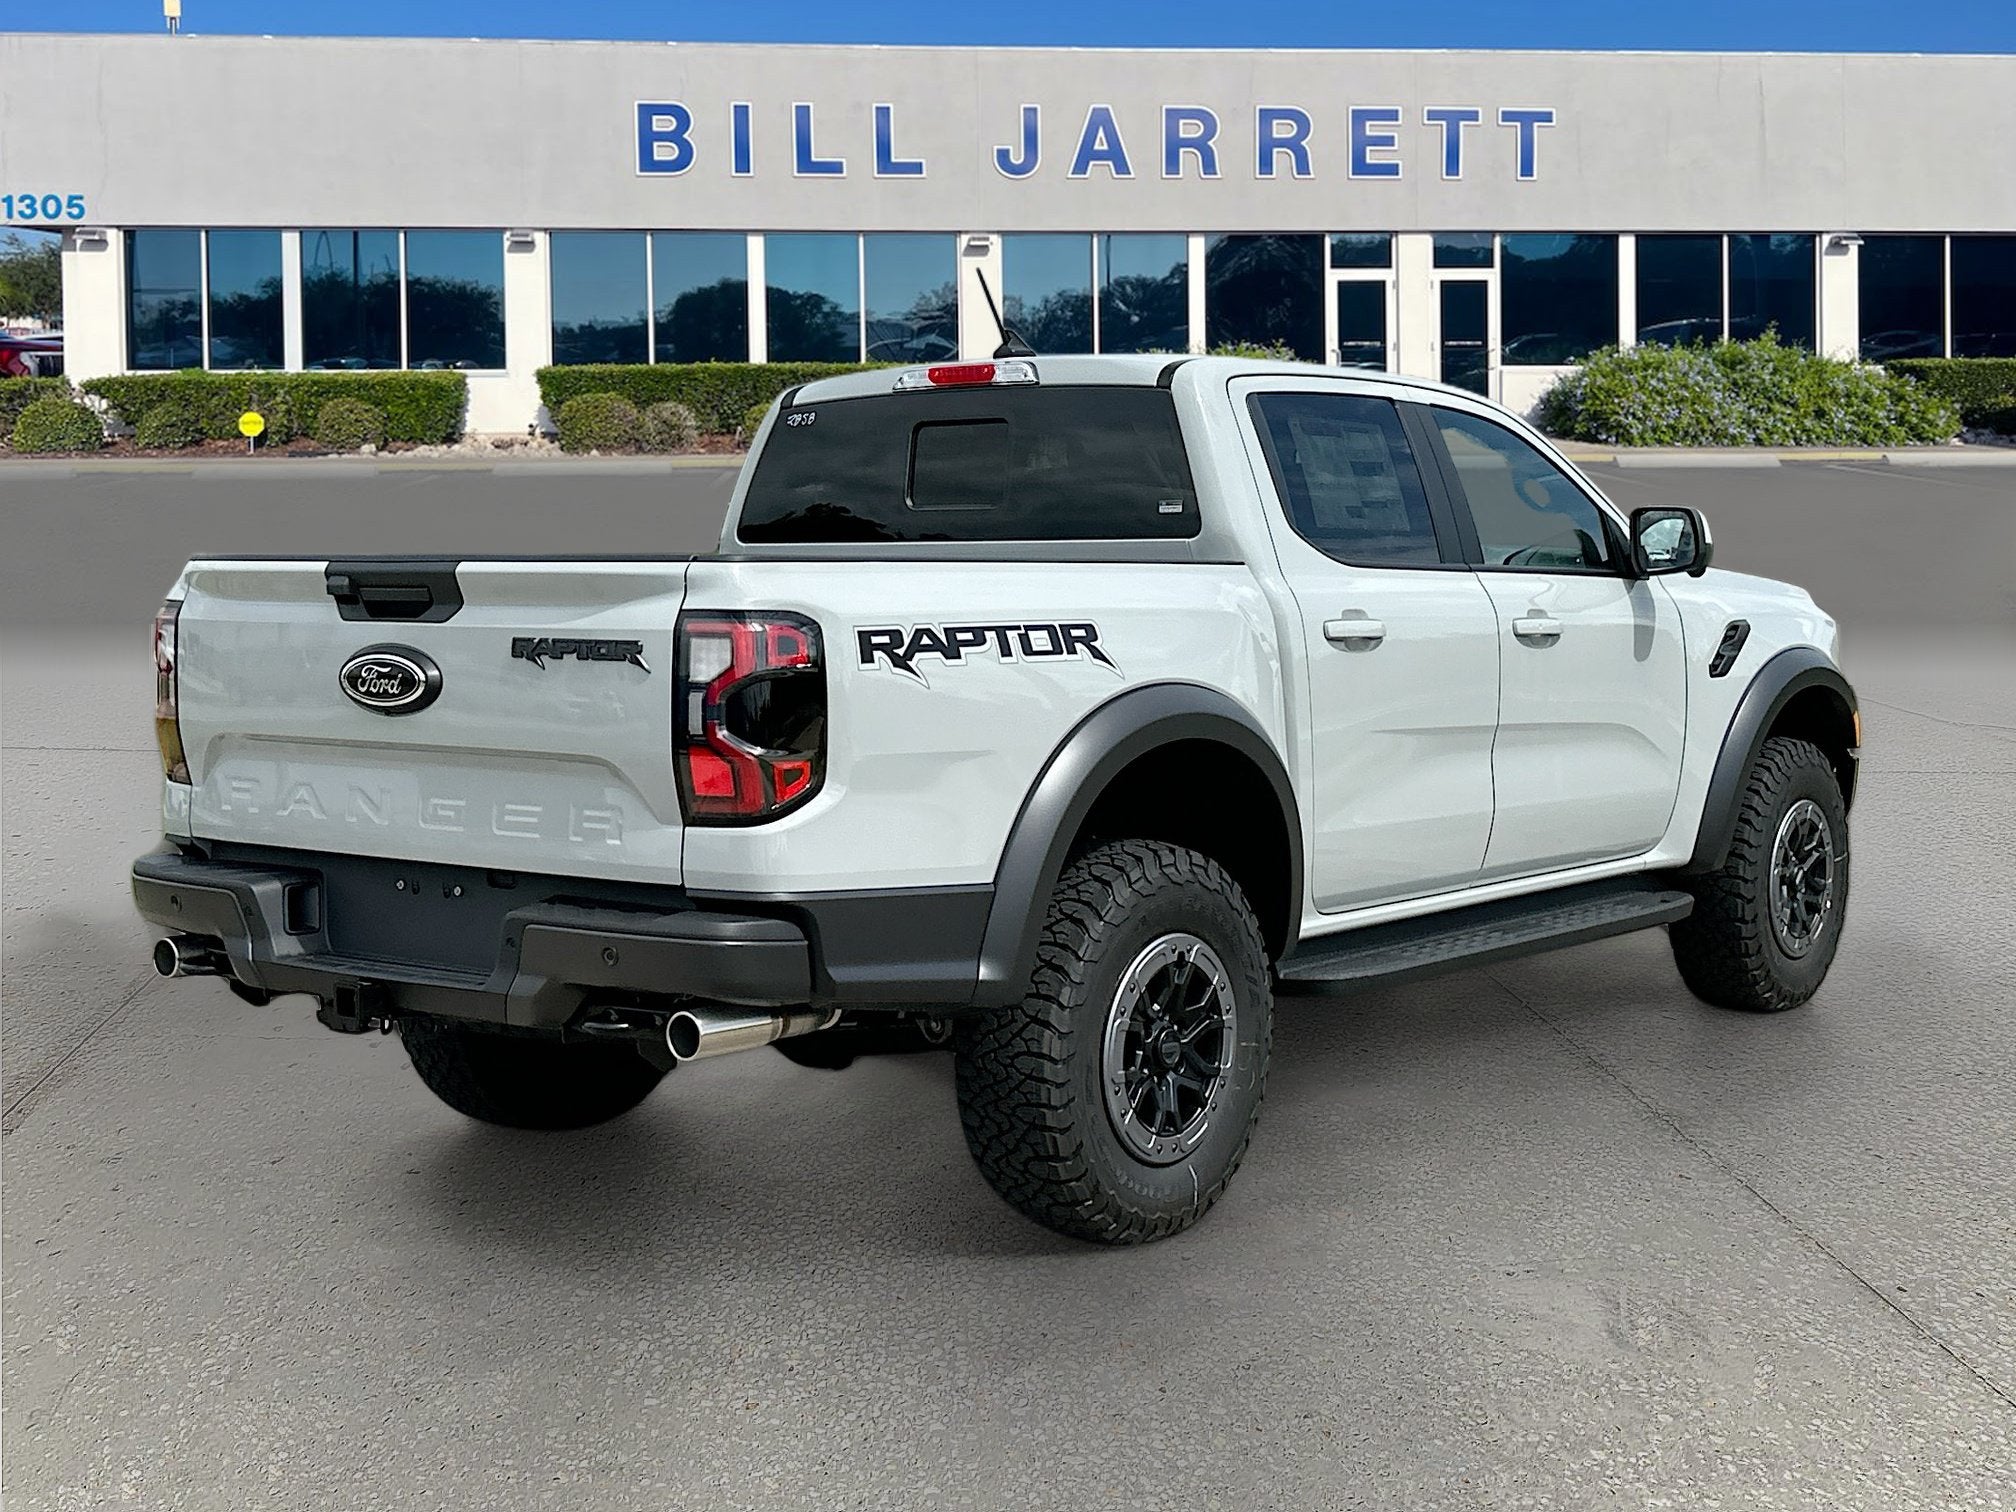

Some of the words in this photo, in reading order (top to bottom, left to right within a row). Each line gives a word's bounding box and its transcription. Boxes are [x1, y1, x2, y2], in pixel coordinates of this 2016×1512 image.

[635, 100, 924, 179] BILL
[992, 103, 1556, 182] JARRETT
[2, 193, 86, 220] 1305
[358, 664, 403, 694] Ford
[511, 637, 650, 673] RAPTOR
[855, 621, 1122, 687] RAPTOR
[220, 774, 624, 846] RANGER
